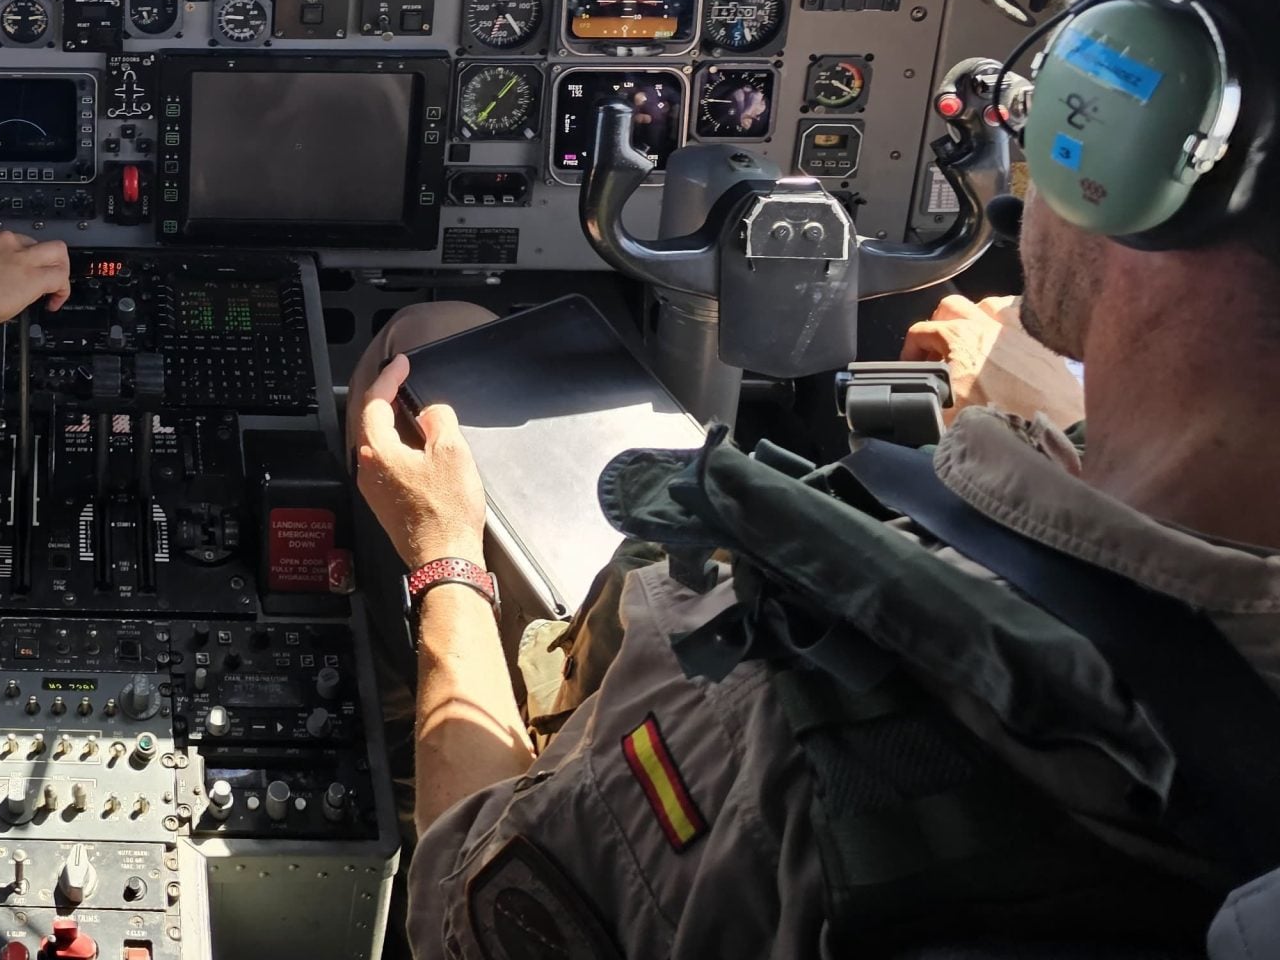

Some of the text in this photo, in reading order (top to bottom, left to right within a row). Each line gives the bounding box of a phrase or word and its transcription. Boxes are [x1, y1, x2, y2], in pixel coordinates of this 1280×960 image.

[272, 521, 334, 530] LANDING GEAR
[277, 530, 327, 539] EMERGENCY
[288, 540, 316, 549] DOWN
[279, 558, 300, 566] OPEN
[271, 566, 308, 574] FULLY TO
